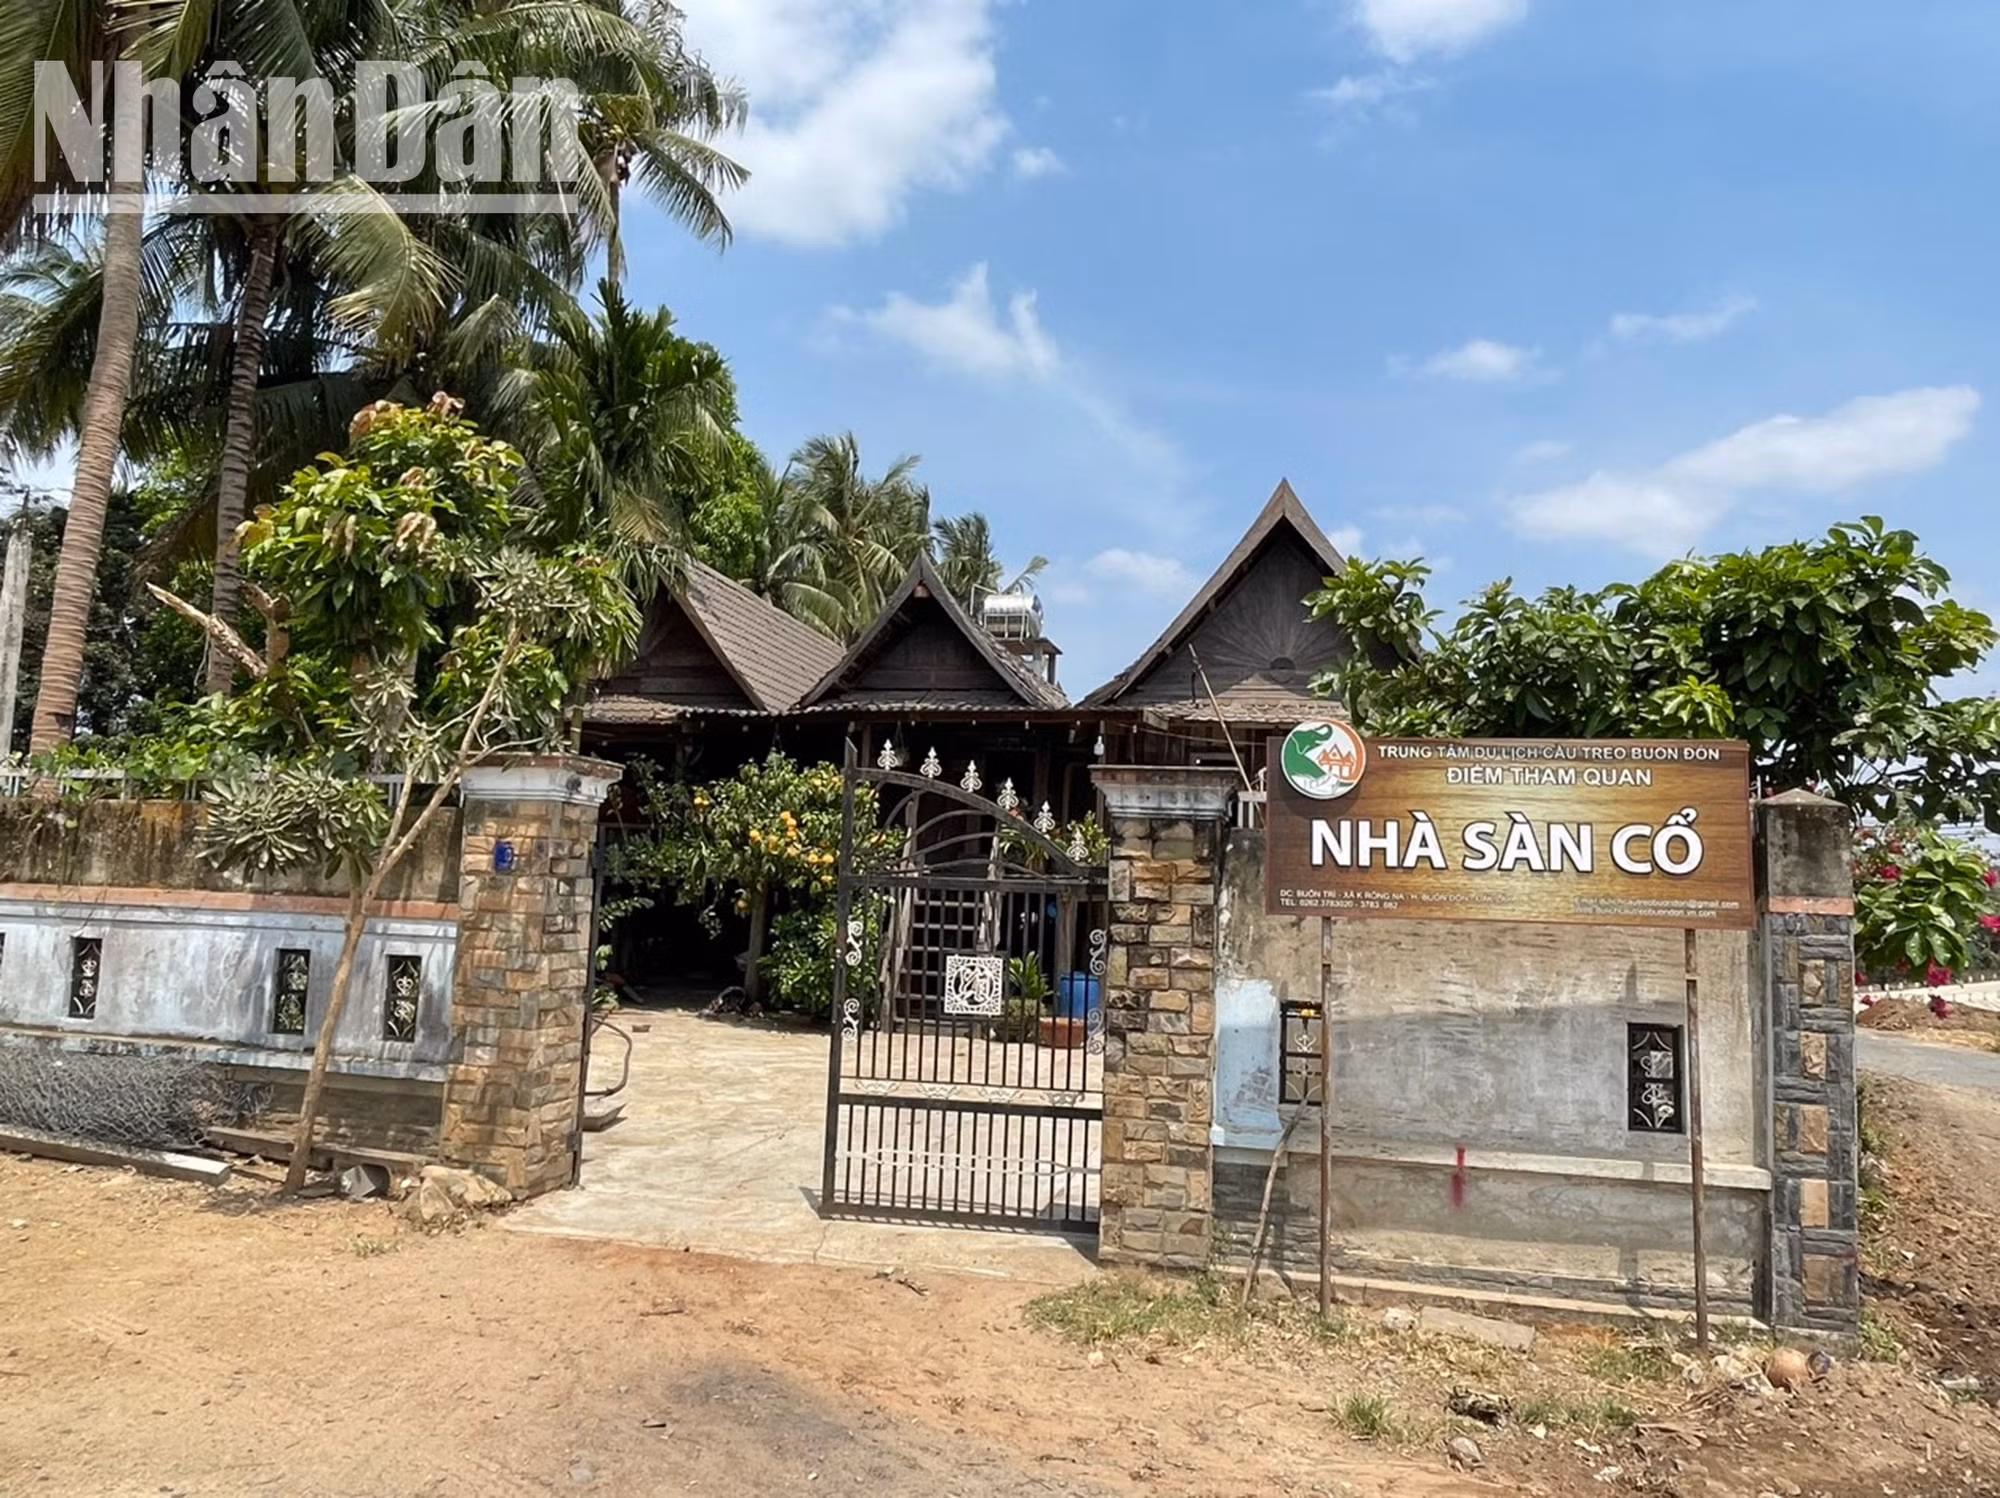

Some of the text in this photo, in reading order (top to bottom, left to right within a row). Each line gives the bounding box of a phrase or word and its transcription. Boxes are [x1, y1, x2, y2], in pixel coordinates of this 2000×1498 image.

[1377, 744, 1433, 758] TRUNG
[1436, 742, 1470, 759] TÂM
[1475, 745, 1500, 759] DU
[1502, 745, 1538, 762] LỊCH
[1581, 746, 1627, 761] TREO
[1511, 767, 1576, 786] THAM
[1582, 767, 1653, 788] QUAN
[1310, 806, 1705, 876] NHÀ SÀN CỔ
